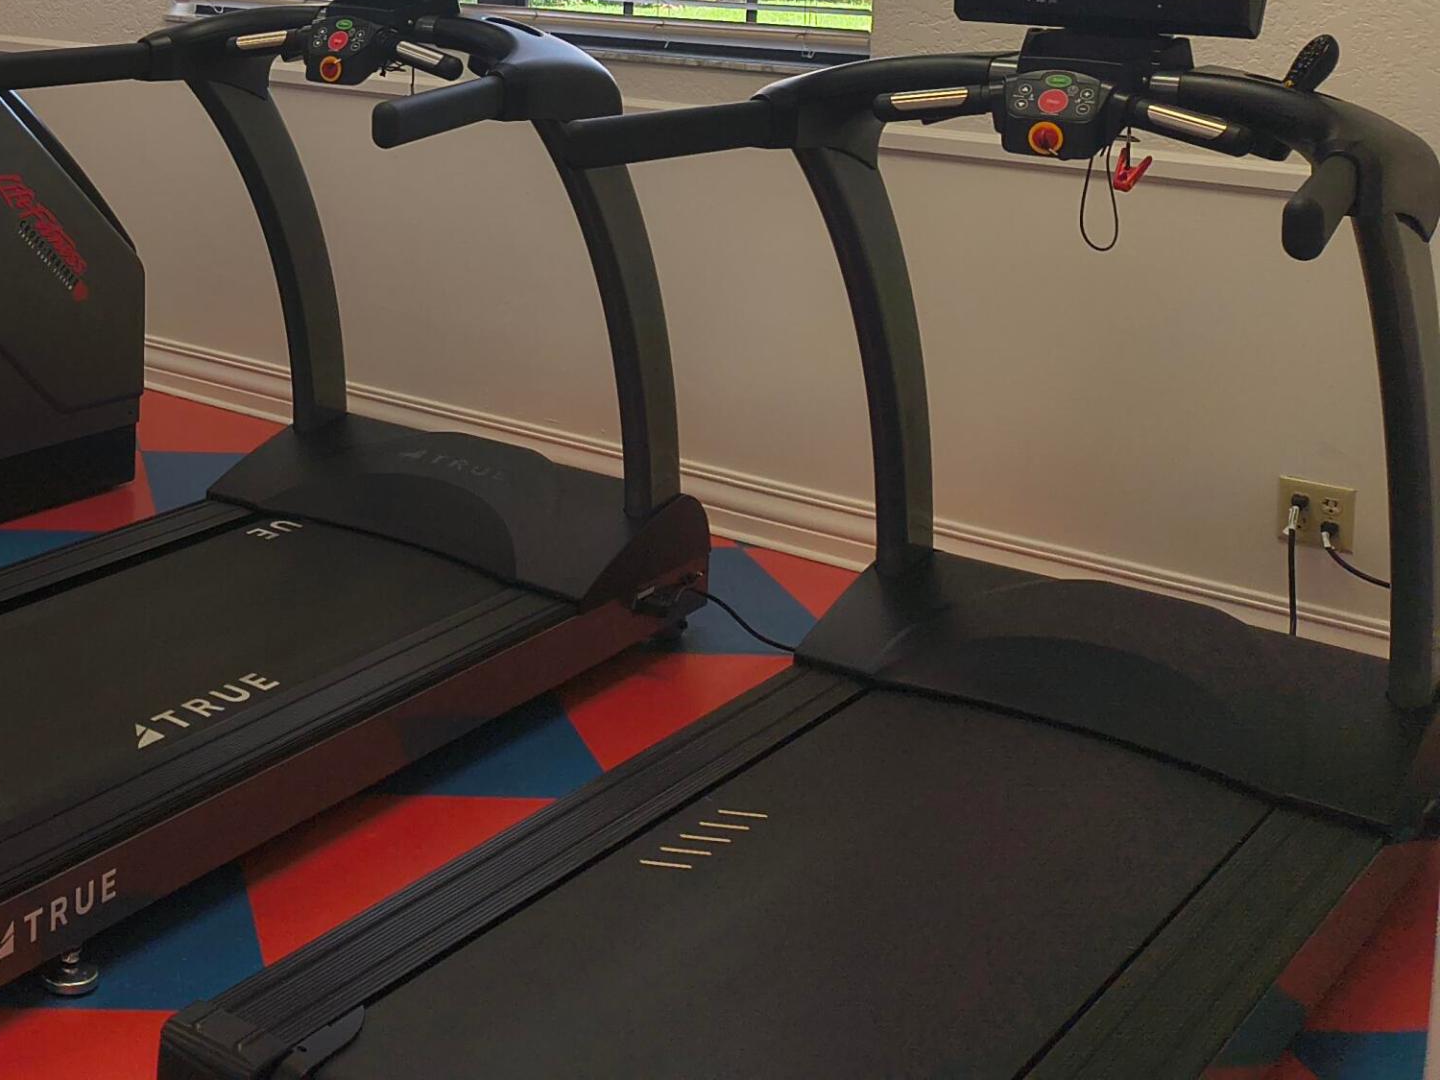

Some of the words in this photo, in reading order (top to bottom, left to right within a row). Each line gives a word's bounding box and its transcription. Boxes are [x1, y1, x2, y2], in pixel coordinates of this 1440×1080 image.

[246, 520, 303, 540] UE
[150, 673, 280, 728] TRUE
[24, 868, 117, 943] TRUE
